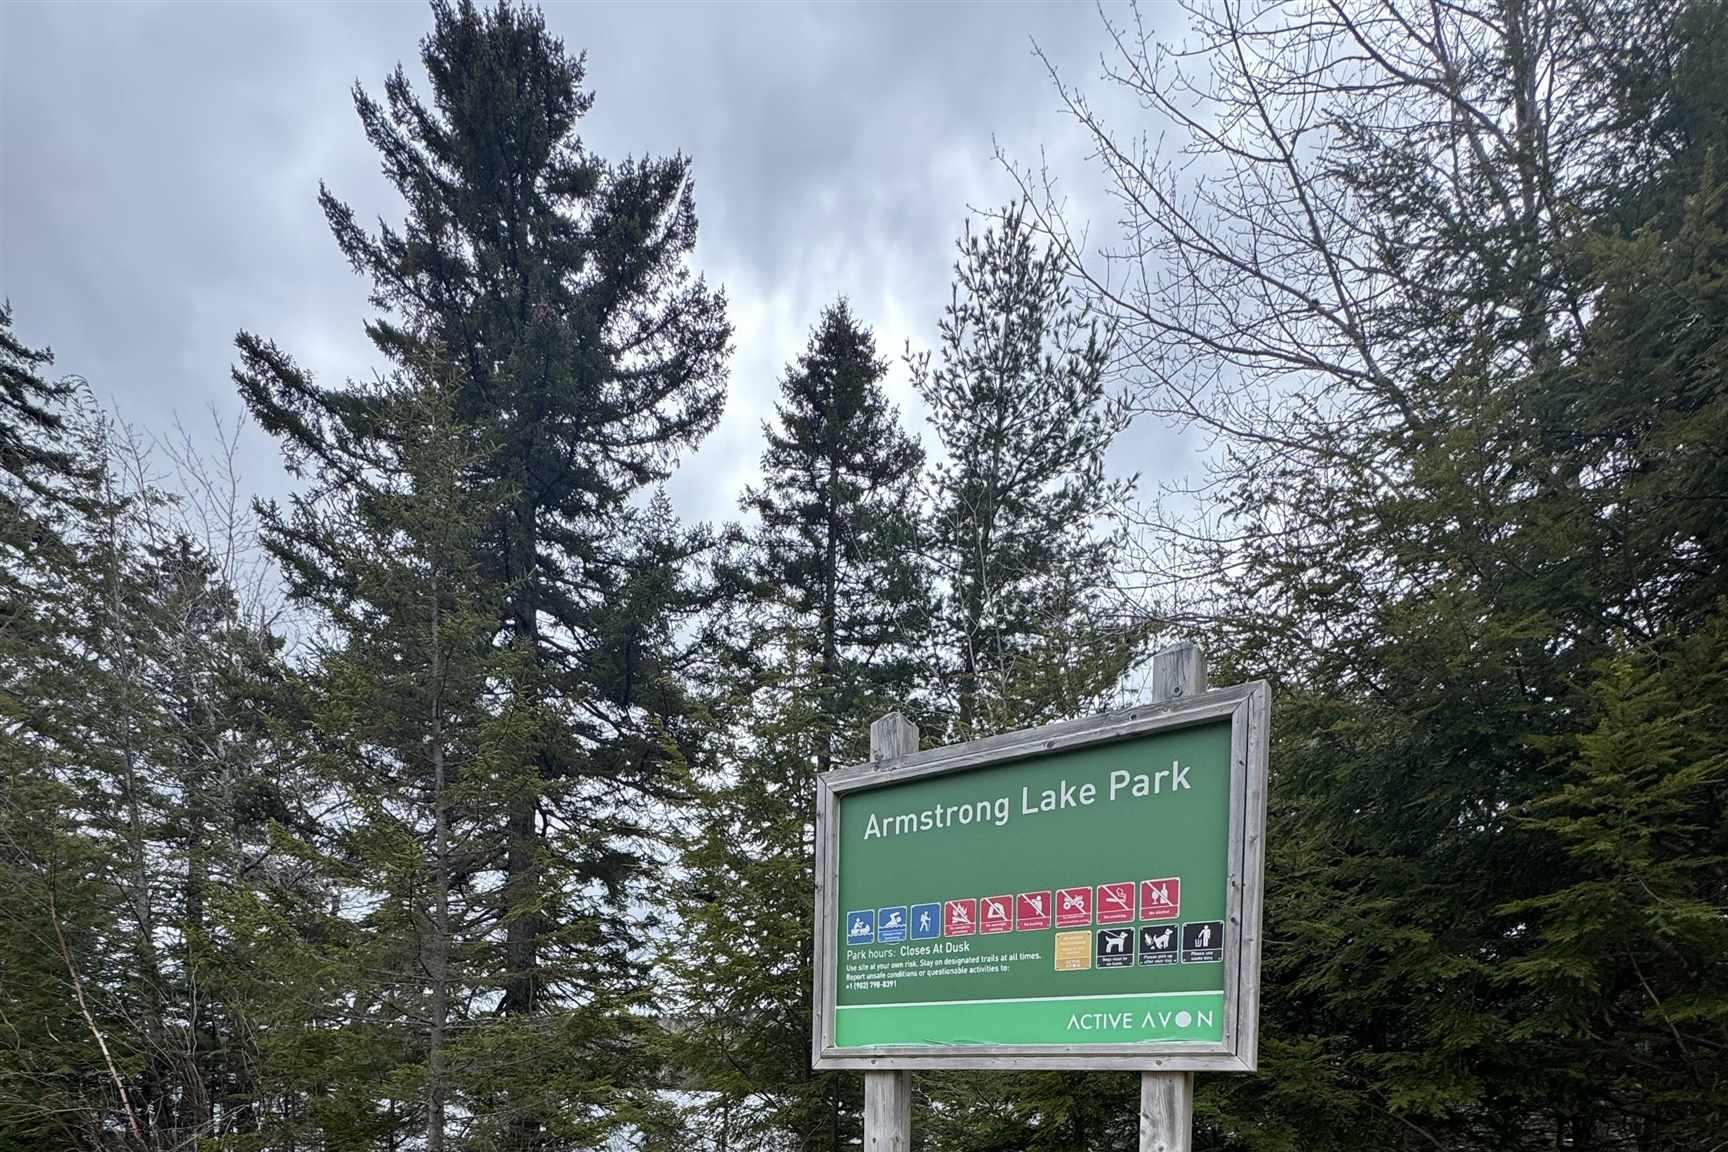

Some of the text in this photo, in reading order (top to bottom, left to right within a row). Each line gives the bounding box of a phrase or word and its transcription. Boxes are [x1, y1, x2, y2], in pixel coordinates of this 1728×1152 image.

[863, 760, 1192, 840] Armstrong Lake Park
[846, 940, 970, 961] Park hours: Closes At Dusk
[846, 964, 857, 972] Use
[870, 962, 876, 971] at
[876, 962, 890, 972] your
[891, 961, 904, 969] own
[919, 958, 934, 969] Stay
[934, 959, 943, 967] on
[944, 956, 980, 966] designated
[981, 954, 999, 963] trails
[1000, 954, 1008, 962] at
[1009, 952, 1018, 961] all
[1019, 952, 1041, 961] times.
[846, 972, 866, 982] Report
[866, 971, 886, 980] unsafe
[887, 970, 918, 979] conditions
[926, 966, 968, 978] questionable
[969, 964, 999, 974] activities
[1000, 964, 1010, 973] to:
[1066, 1010, 1213, 1030] ACTIVE AVON
